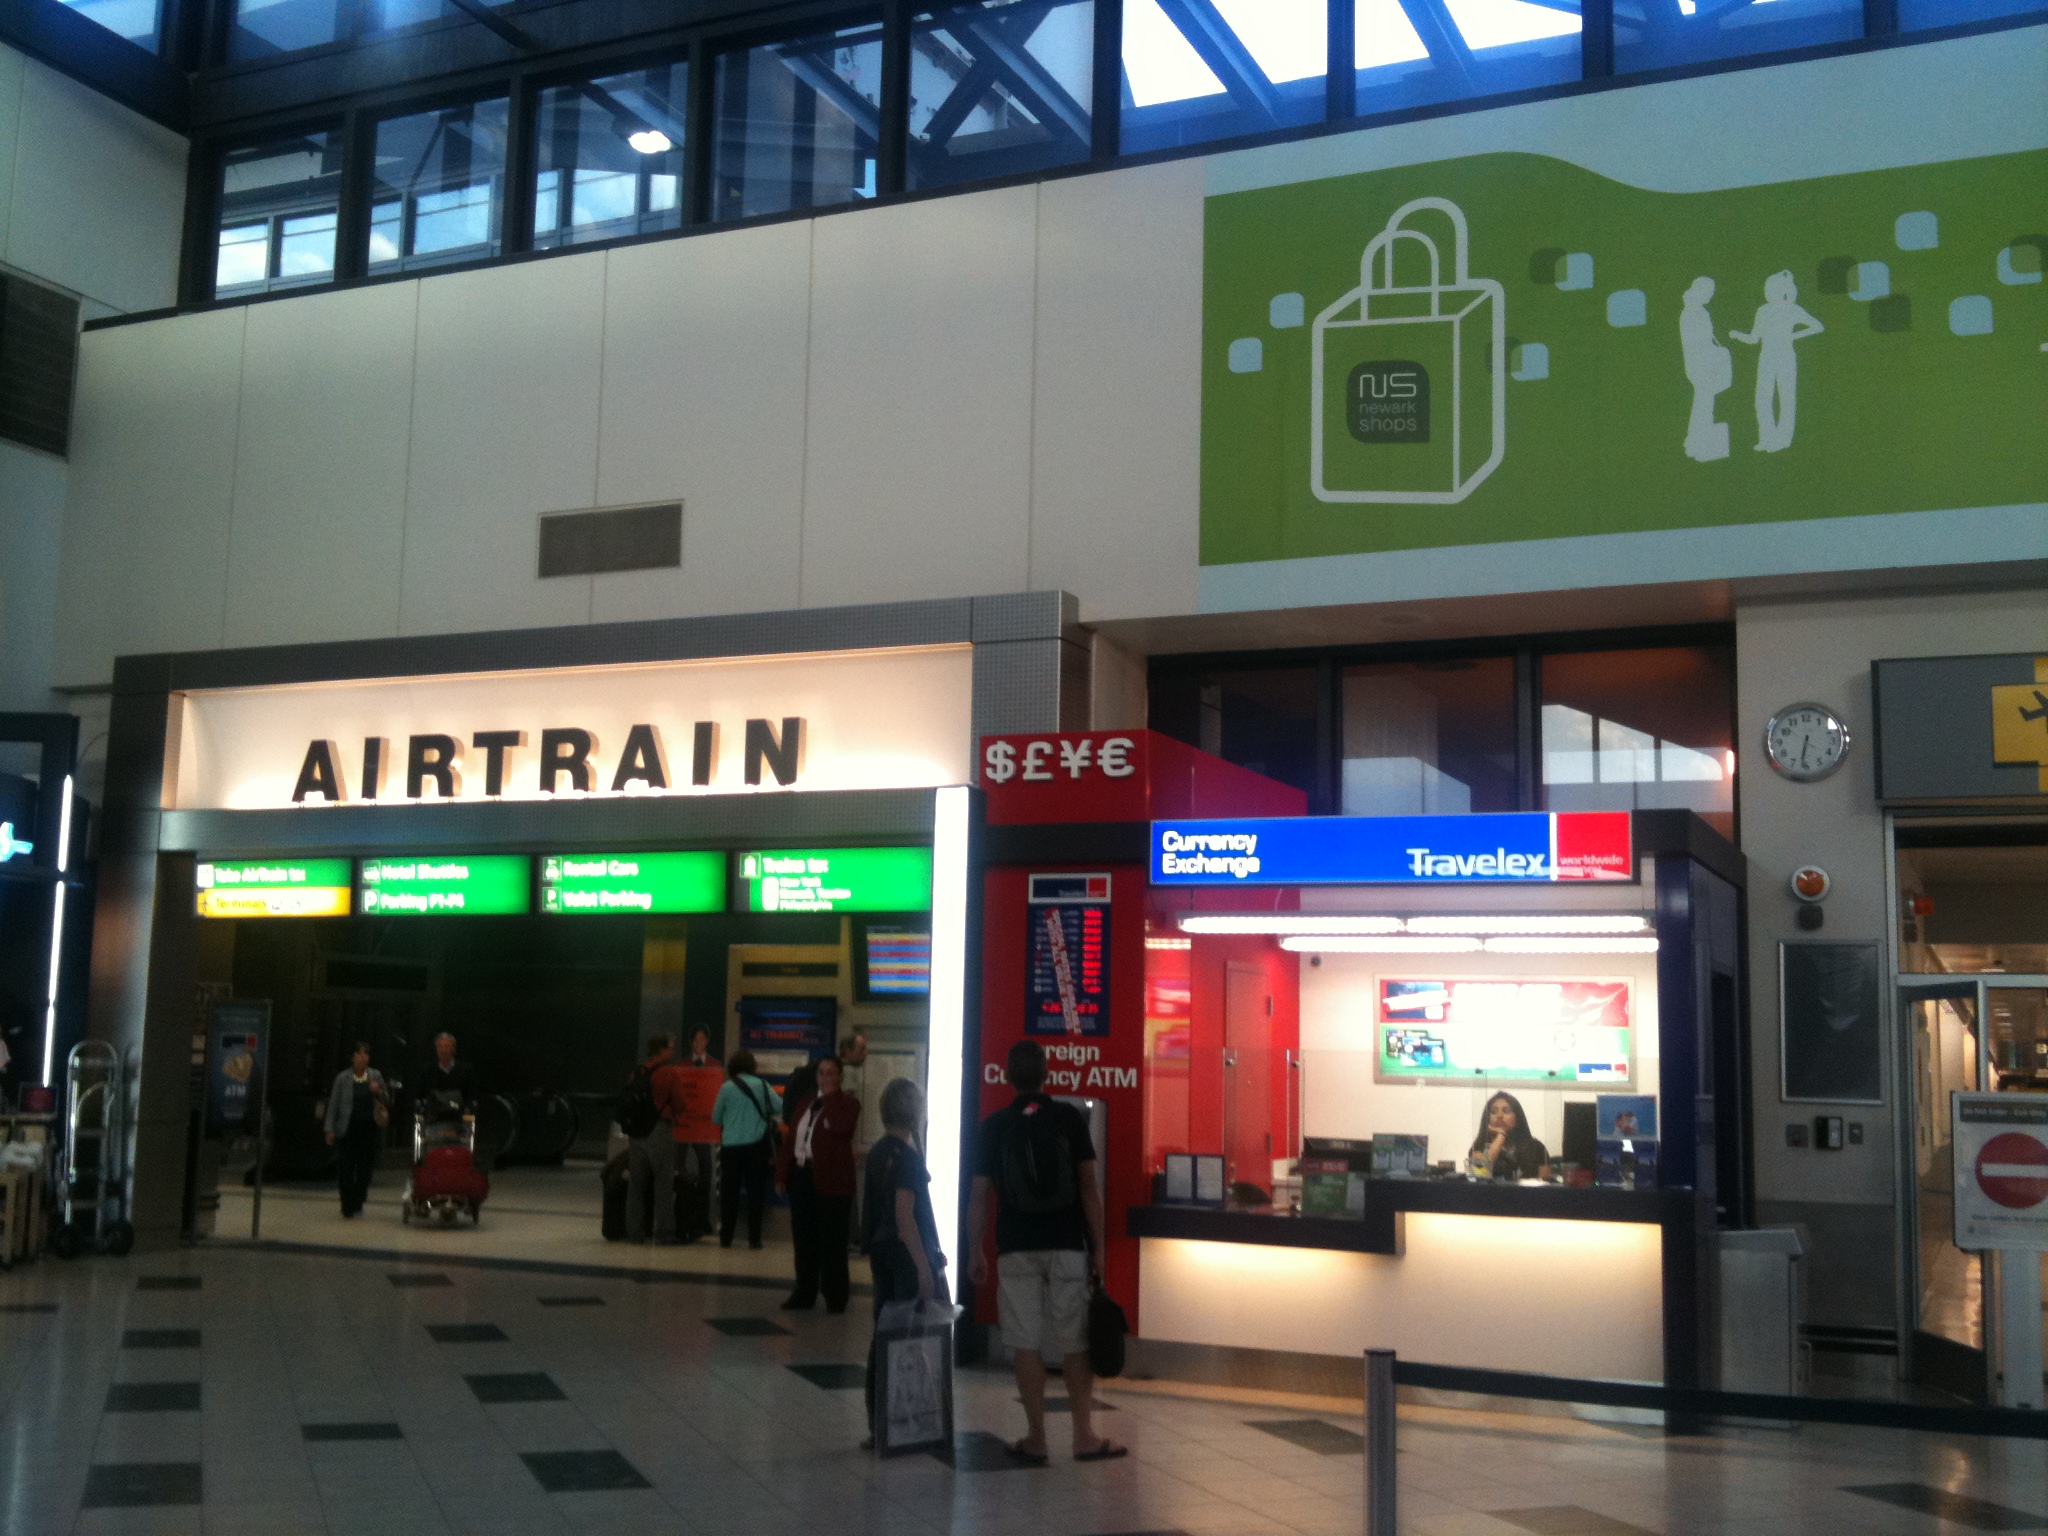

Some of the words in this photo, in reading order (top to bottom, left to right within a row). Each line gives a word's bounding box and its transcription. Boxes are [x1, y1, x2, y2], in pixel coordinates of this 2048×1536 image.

[1360, 402, 1417, 414] newark
[1360, 416, 1417, 434] shops
[291, 716, 808, 804] AIRTRAIN
[1162, 830, 1258, 856] Currency
[1162, 852, 1261, 879] Exchange
[1406, 848, 1546, 878] Travelex
[1042, 1041, 1101, 1067] reign
[1086, 1067, 1138, 1089] ATM
